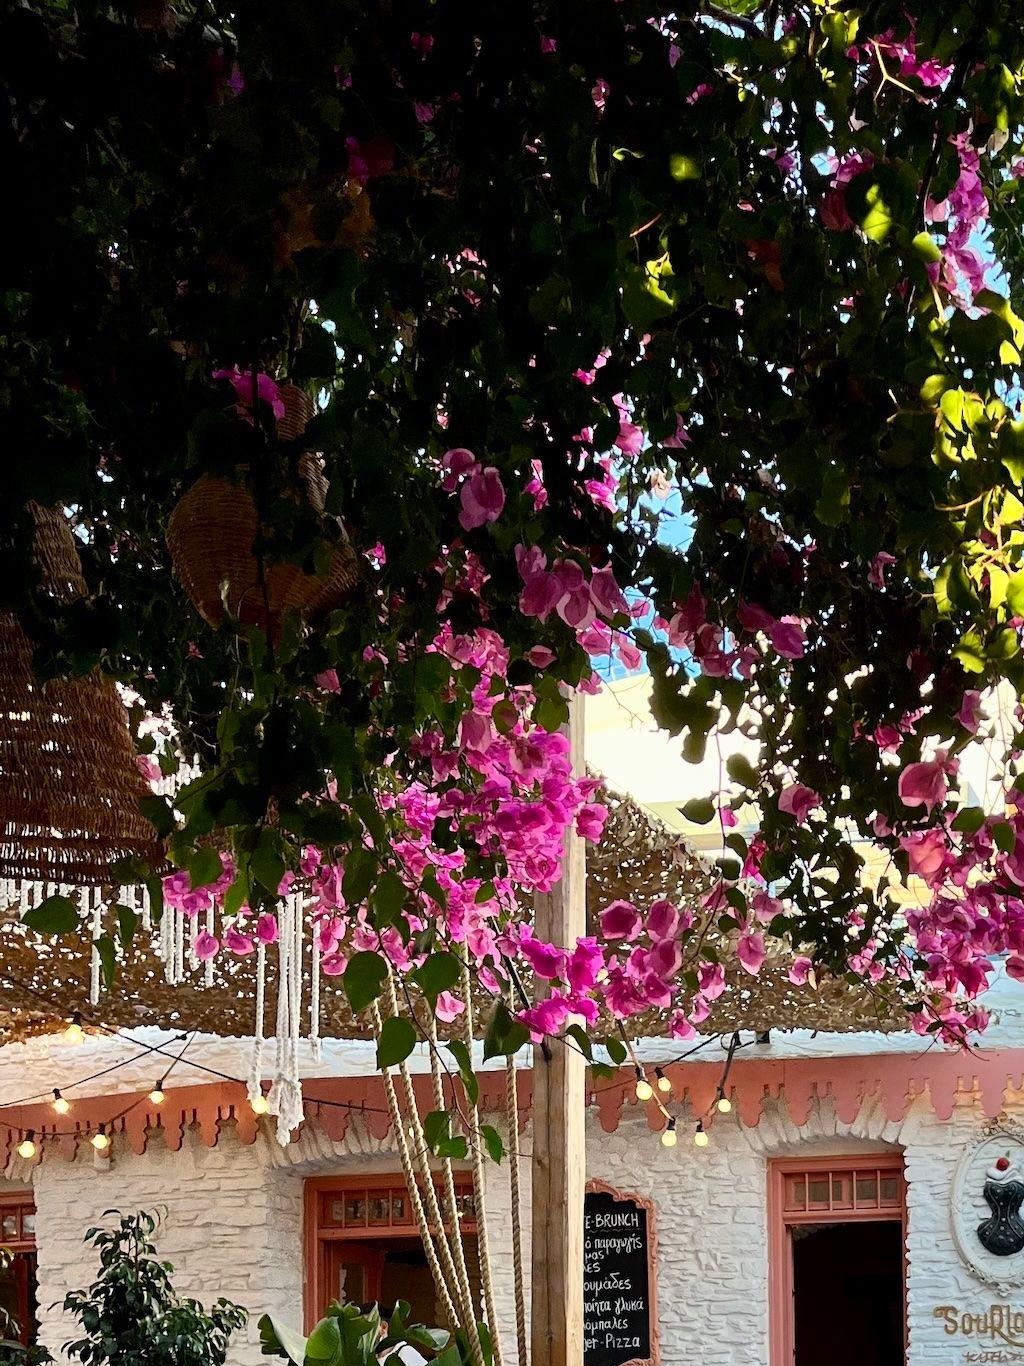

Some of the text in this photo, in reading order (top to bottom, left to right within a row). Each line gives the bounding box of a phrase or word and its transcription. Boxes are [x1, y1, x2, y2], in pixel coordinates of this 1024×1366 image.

[584, 1213, 639, 1229] E-BRUNCH
[584, 1272, 632, 1297] ουμάδες
[584, 1316, 629, 1336] όμπαλες
